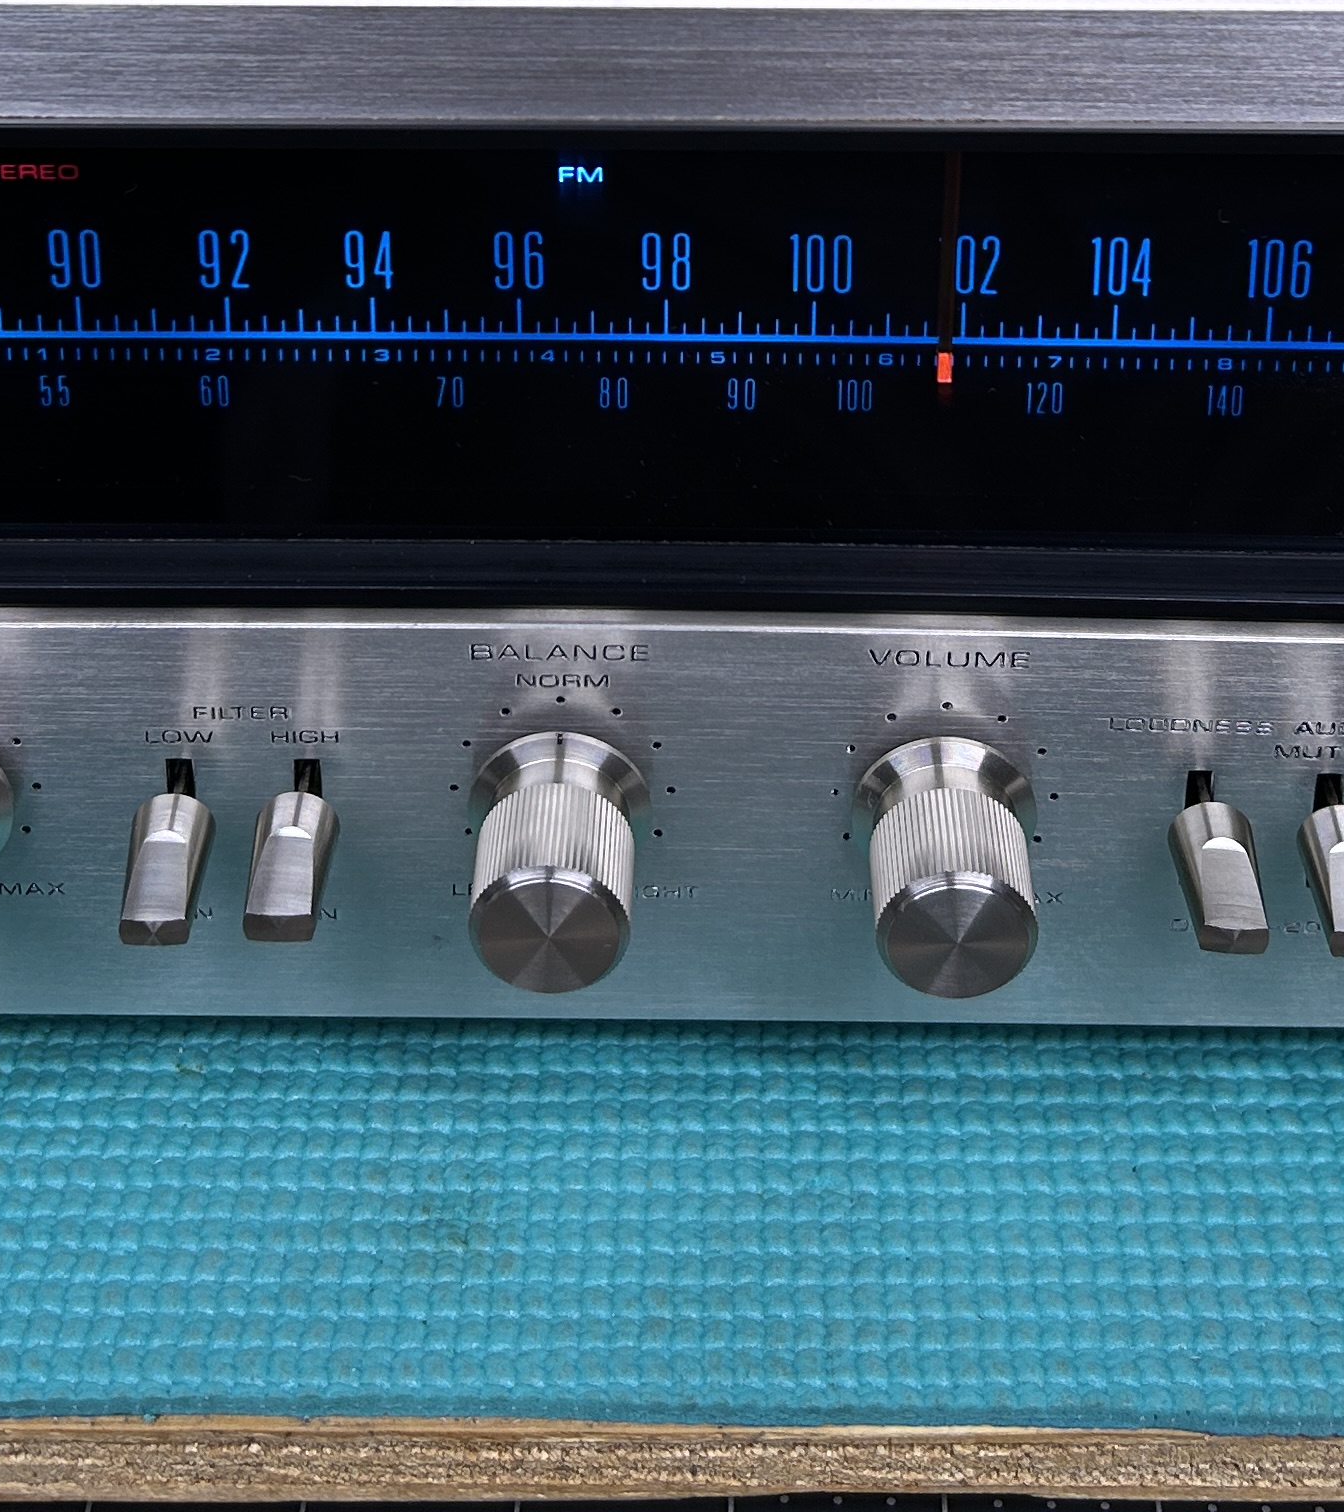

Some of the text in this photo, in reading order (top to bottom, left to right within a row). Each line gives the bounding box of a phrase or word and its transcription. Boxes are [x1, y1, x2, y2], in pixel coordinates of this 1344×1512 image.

[557, 165, 604, 184] FM
[47, 228, 102, 289] 90
[197, 229, 251, 289] 92
[343, 229, 394, 290] 94
[493, 230, 545, 291] 96
[641, 231, 691, 292] 98
[789, 233, 853, 295] 100
[954, 234, 1001, 296] 02
[1091, 236, 1152, 297] 104
[1247, 238, 1314, 299] 106
[37, 347, 47, 362] 1
[205, 347, 221, 362] 2
[374, 348, 390, 362] 3
[540, 349, 555, 362] 4
[710, 350, 726, 365] 5
[878, 352, 894, 367] 6
[1048, 355, 1063, 369] 7
[1217, 357, 1233, 372] 8
[39, 374, 71, 407] 55
[199, 374, 230, 408] 60
[436, 375, 464, 409] 70
[599, 376, 628, 410] 80
[727, 377, 756, 411] 90
[837, 378, 873, 412] 100
[1026, 381, 1064, 415] 120
[1207, 384, 1244, 417] 140
[469, 642, 650, 663] BALANCE
[867, 648, 1032, 669] VOLUME
[515, 672, 611, 689] NORM
[192, 705, 290, 721] FILTER
[144, 729, 215, 745] LOW
[270, 729, 341, 745] HIGH
[1108, 716, 1275, 737] LOUDNESS
